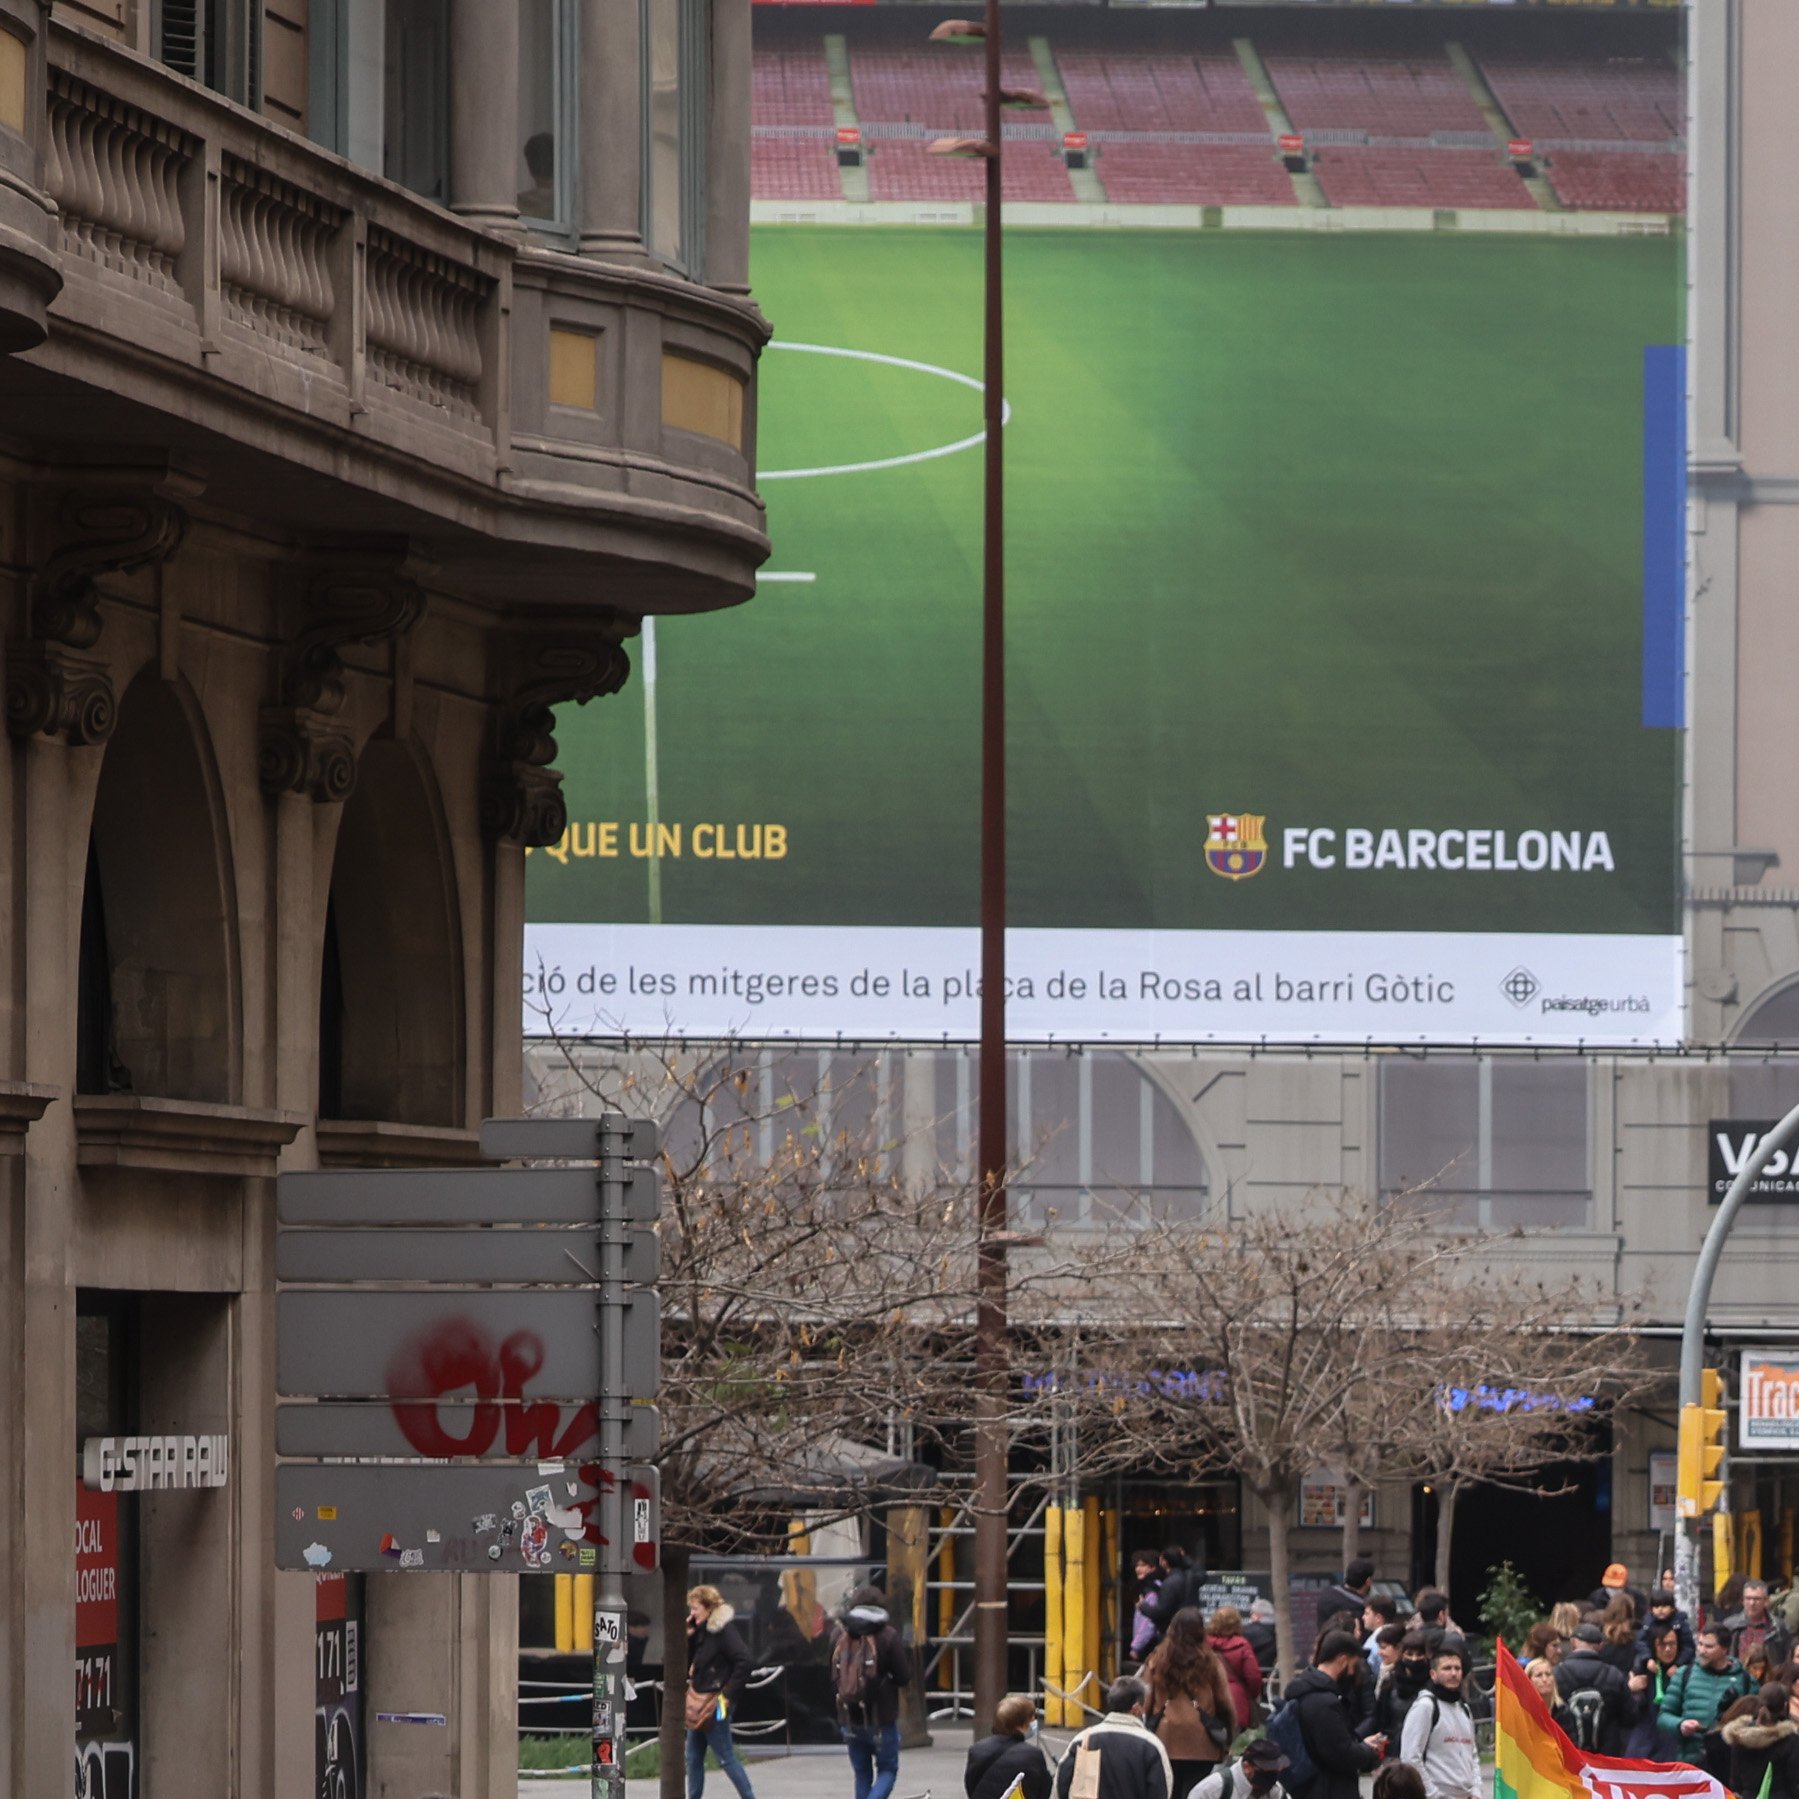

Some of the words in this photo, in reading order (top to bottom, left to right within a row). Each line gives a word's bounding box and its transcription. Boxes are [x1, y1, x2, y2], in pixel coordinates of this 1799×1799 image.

[544, 822, 619, 864] QUE
[628, 822, 682, 858] UN
[691, 823, 789, 860] CLUB
[1283, 827, 1336, 869] FC
[1346, 828, 1615, 873] BARCELONA
[577, 965, 617, 996] de
[629, 965, 677, 996] les
[690, 966, 839, 1005] mitgeres
[850, 968, 891, 998] de
[903, 968, 931, 998] la
[1047, 970, 1087, 1000] de
[1100, 971, 1128, 1001] la
[1140, 971, 1222, 1002] Rosa
[1233, 973, 1263, 1003] al
[1274, 973, 1355, 1003] barri
[1366, 973, 1456, 1006] Gòtic
[182, 1434, 230, 1489] RAW
[595, 1616, 618, 1641] SATO
